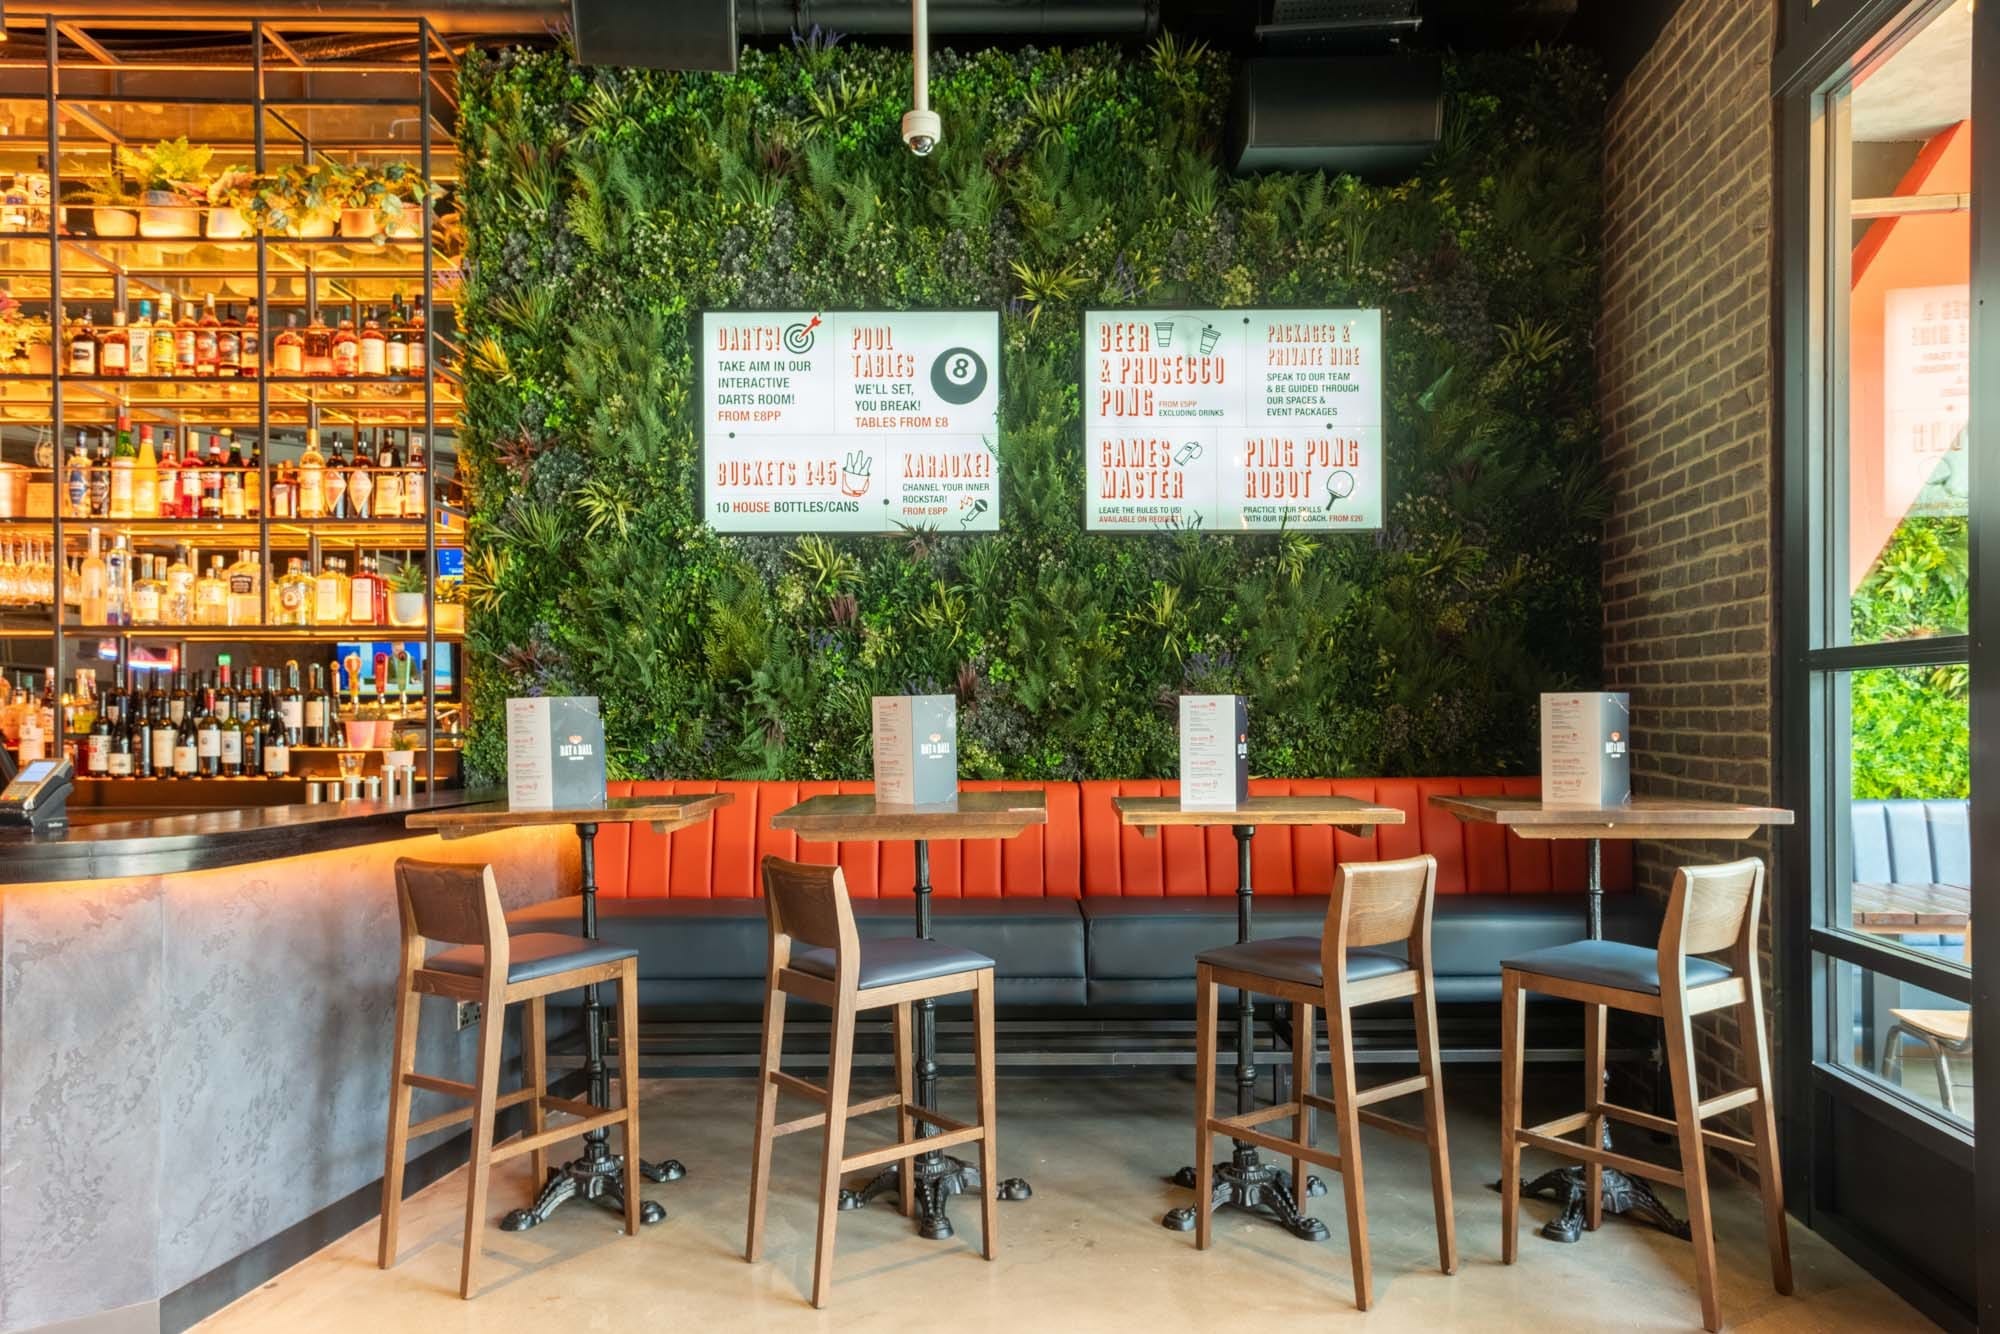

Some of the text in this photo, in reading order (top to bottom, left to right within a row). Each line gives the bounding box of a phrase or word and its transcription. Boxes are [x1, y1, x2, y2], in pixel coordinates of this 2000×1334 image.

[718, 327, 780, 351] DARTS!
[852, 326, 893, 350] POOL
[1100, 322, 1150, 352] BEER
[1268, 324, 1350, 342] PACKAGES &
[852, 354, 914, 378] TABLES
[1267, 348, 1360, 366] PRIVATE HIRE
[718, 361, 811, 372] TAKE AIM IN OUR
[952, 358, 968, 378] 8
[1100, 356, 1224, 384] & PROSECCO
[718, 378, 790, 388] INTERACTIVE
[1266, 373, 1350, 381] SPEAK TO OUR TEAM
[855, 384, 914, 396] WE'LL SET,
[1266, 384, 1359, 392] & BE GUIDED THROUGH
[718, 394, 794, 405] DARTS ROOM!
[855, 400, 920, 411] YOU BREAK!
[1100, 388, 1153, 416] PONG
[1266, 396, 1326, 404] OUR SPACES &
[718, 411, 780, 422] FROM £8PP
[1266, 408, 1338, 416] EVENT PACKAGES
[856, 417, 948, 428] TABLES FROM £8
[1102, 440, 1171, 468] GAMES
[1244, 438, 1359, 467] PING PONG
[716, 461, 837, 486] BUCKETS £45
[902, 453, 990, 478] KARAOKE!
[902, 483, 990, 491] CHANNEL YOUR INNER
[1100, 470, 1184, 499] MASTER
[1244, 470, 1312, 498] ROBOT
[716, 502, 859, 513] 10 HOUSE BOTTLES/CANS
[902, 495, 948, 503] ROCKSTAR!
